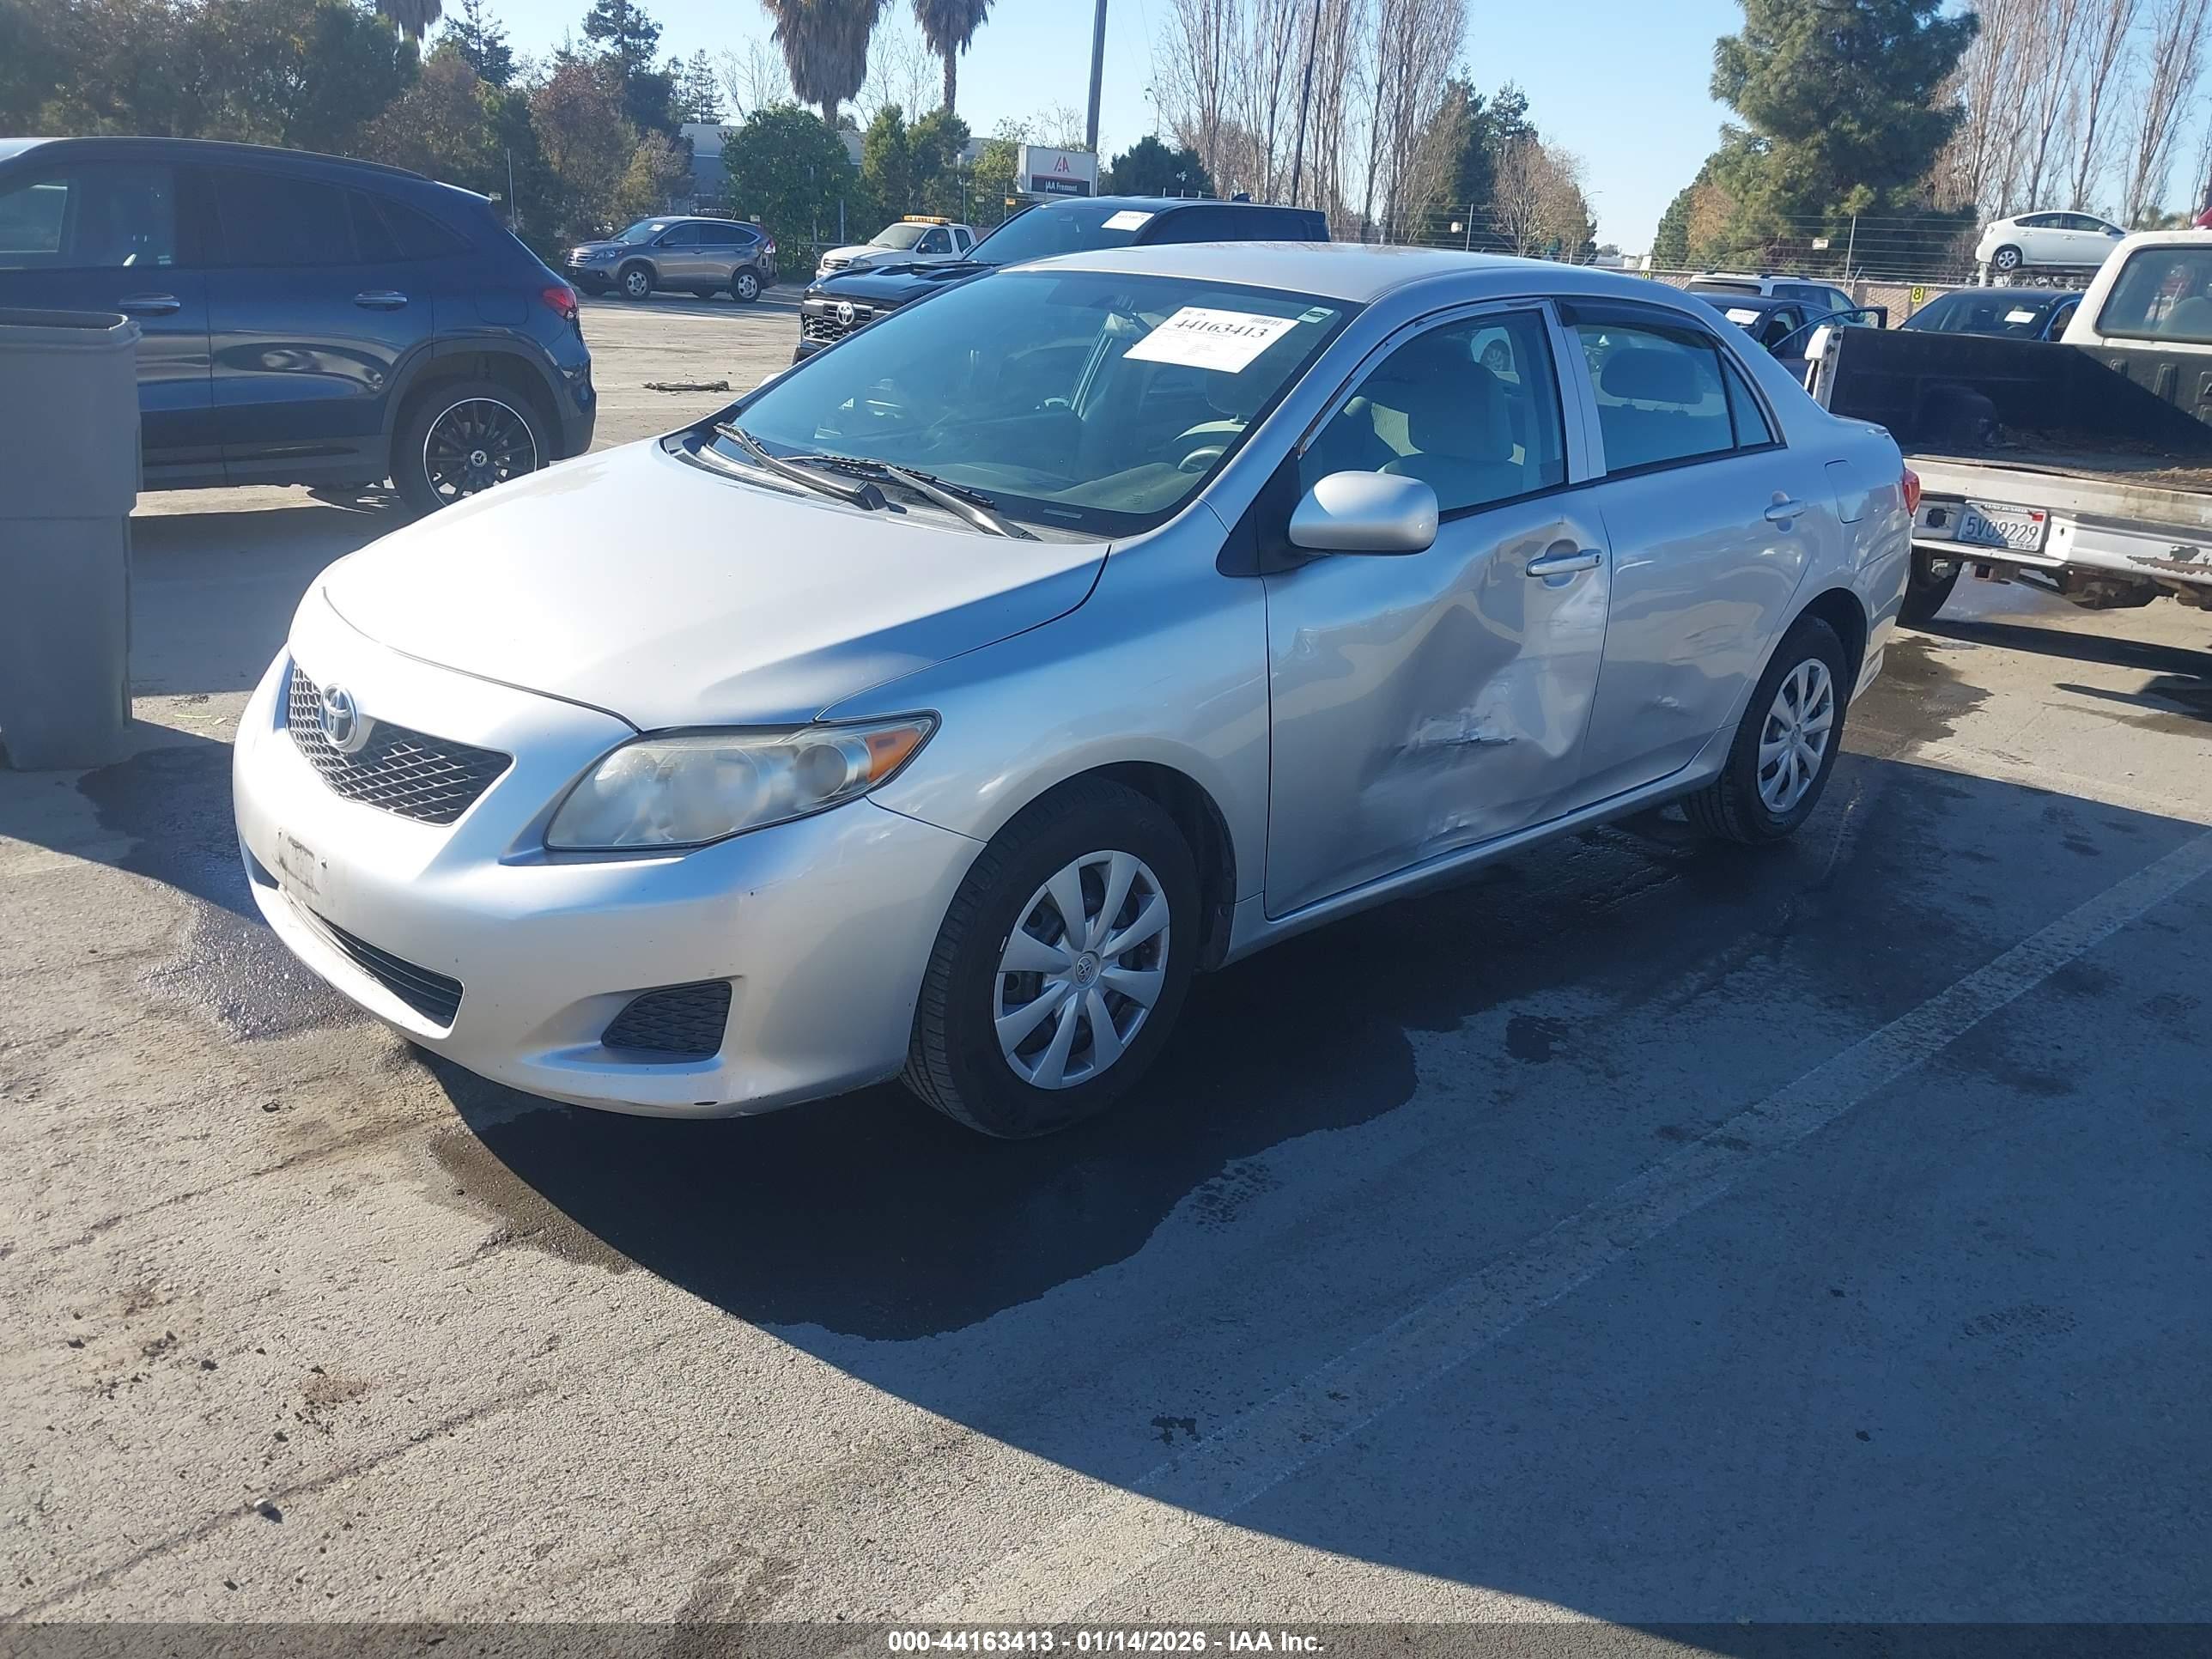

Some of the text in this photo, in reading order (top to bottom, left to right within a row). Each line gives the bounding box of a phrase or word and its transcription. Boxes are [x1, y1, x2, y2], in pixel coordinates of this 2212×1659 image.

[1056, 182, 1078, 192] Fremont
[1913, 288, 1921, 300] 8
[1174, 319, 1269, 338] 44163413
[1966, 517, 2039, 544] 5V09229
